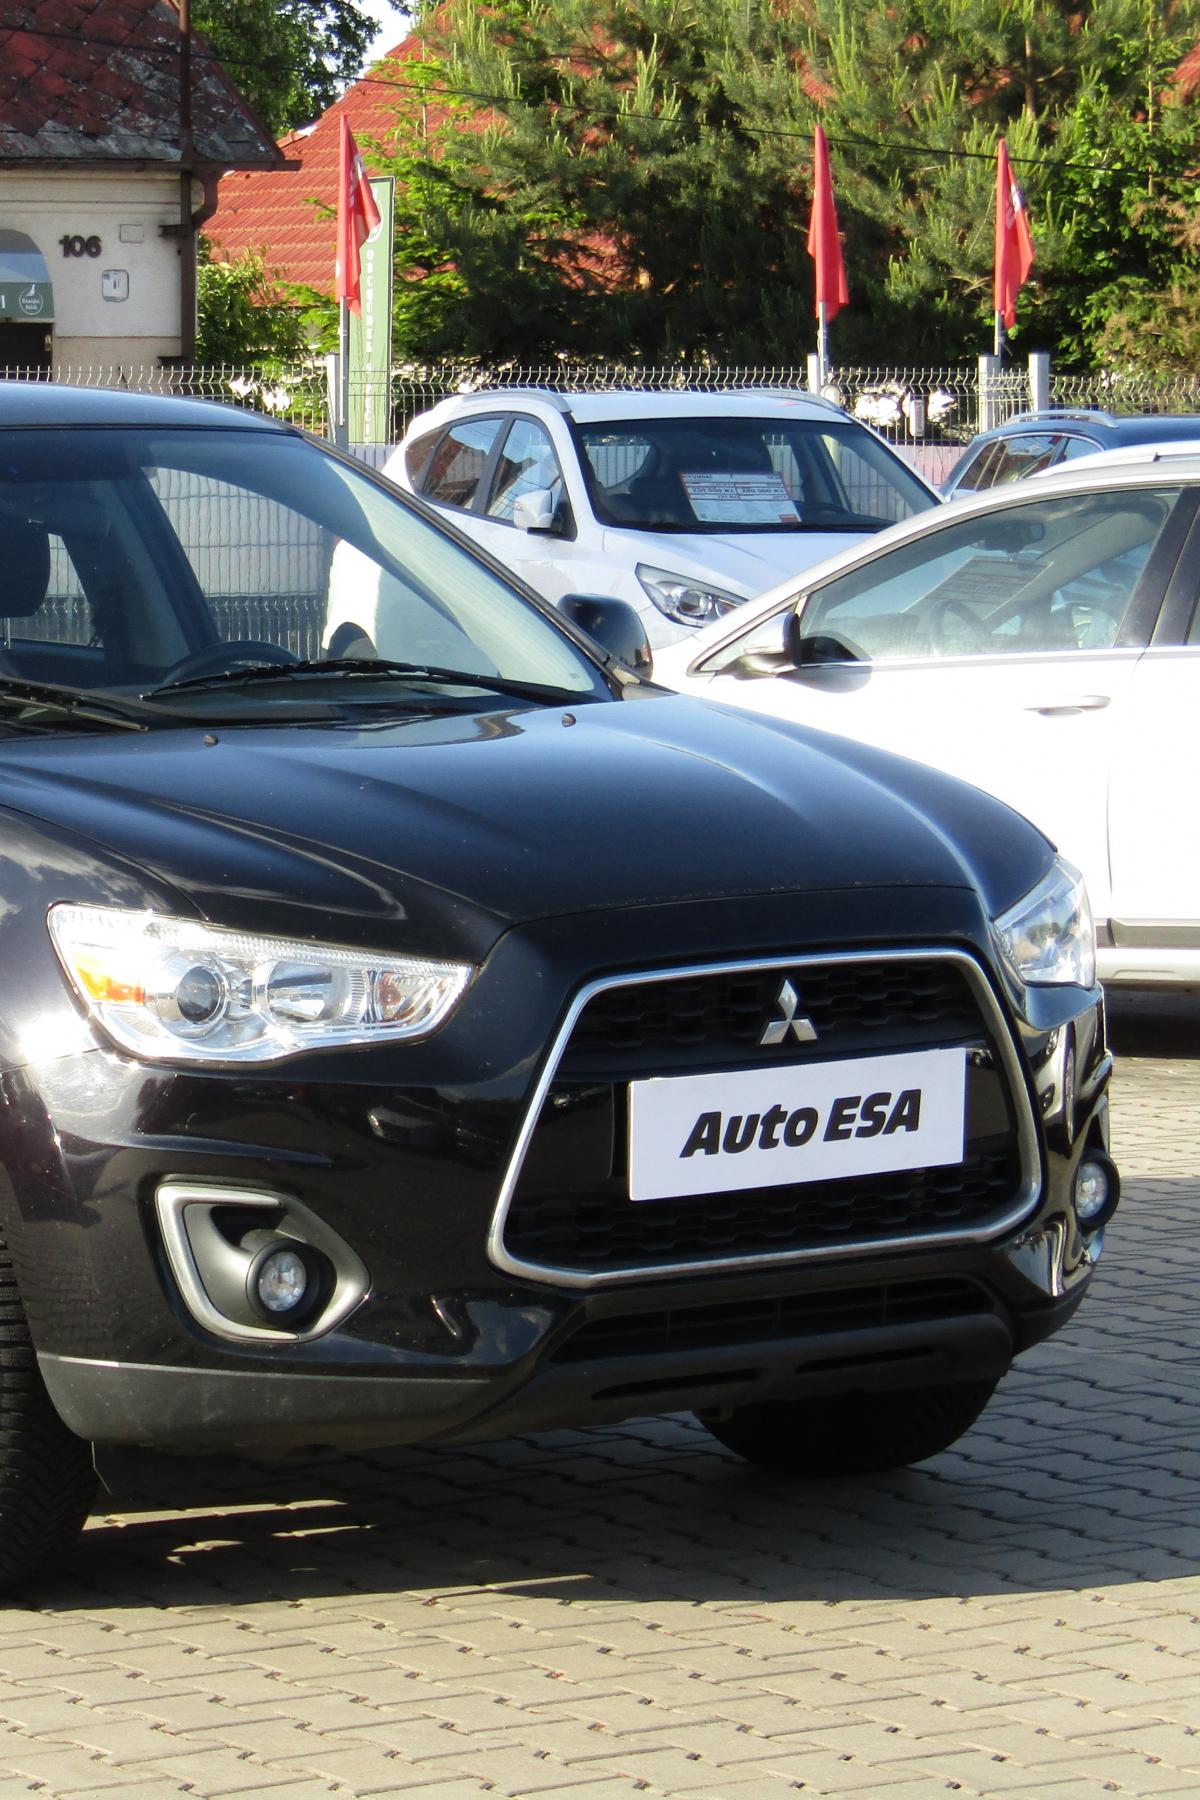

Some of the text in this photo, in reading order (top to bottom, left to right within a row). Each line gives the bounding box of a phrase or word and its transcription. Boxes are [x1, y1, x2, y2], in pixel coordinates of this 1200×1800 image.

[59, 235, 102, 258] 106
[679, 1088, 923, 1159] Auto ESA
